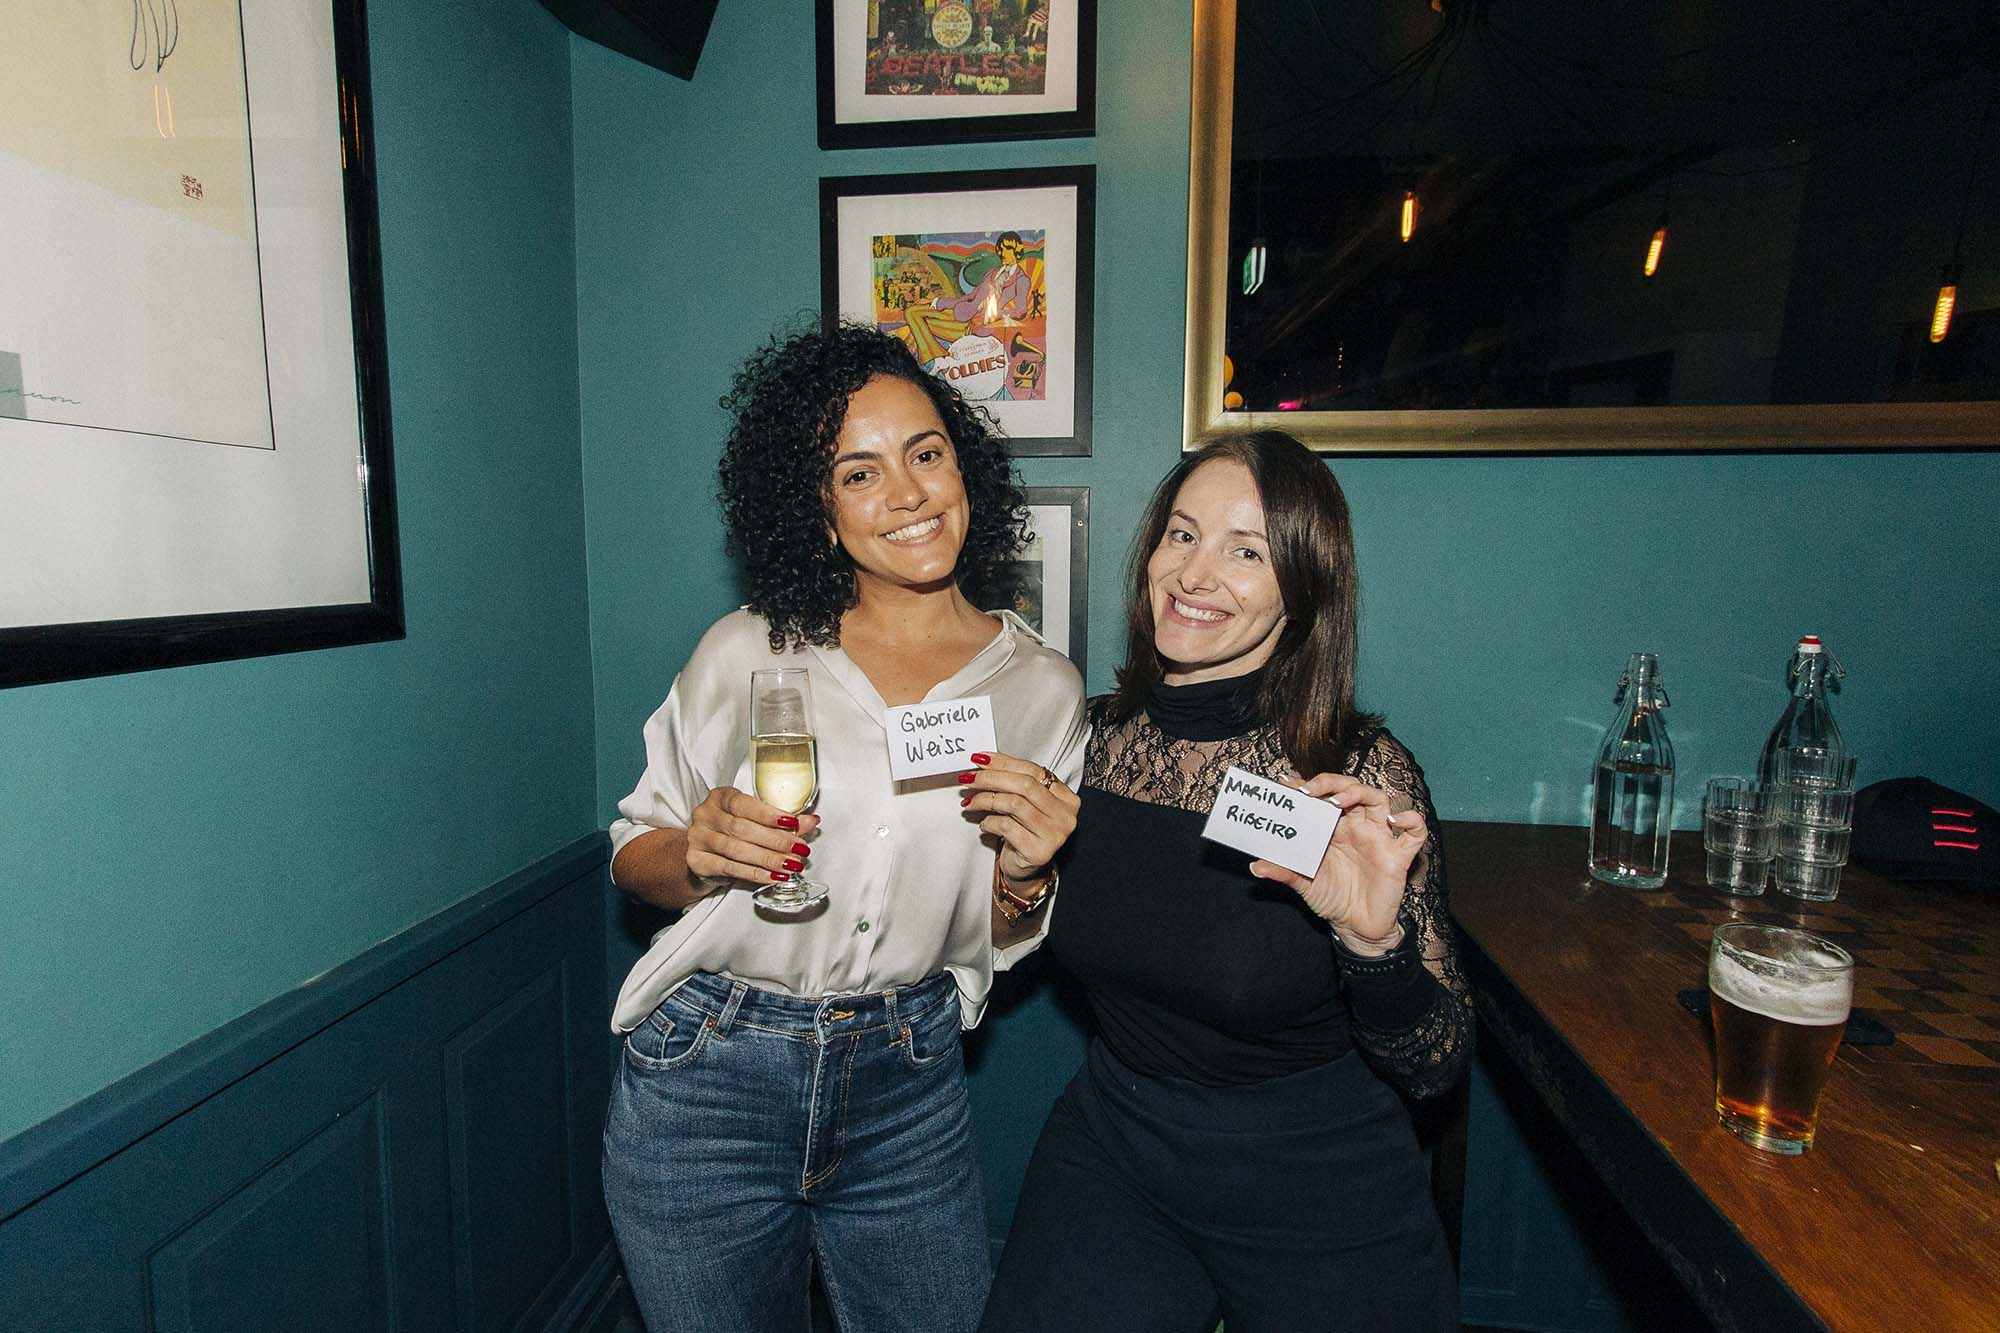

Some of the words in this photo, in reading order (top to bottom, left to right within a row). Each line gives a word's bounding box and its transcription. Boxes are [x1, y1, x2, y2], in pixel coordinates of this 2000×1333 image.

[881, 54, 1025, 77] BEATLES
[949, 354, 1006, 380] OLDIES
[901, 705, 980, 733] Gabriela
[905, 735, 966, 763] Weiss
